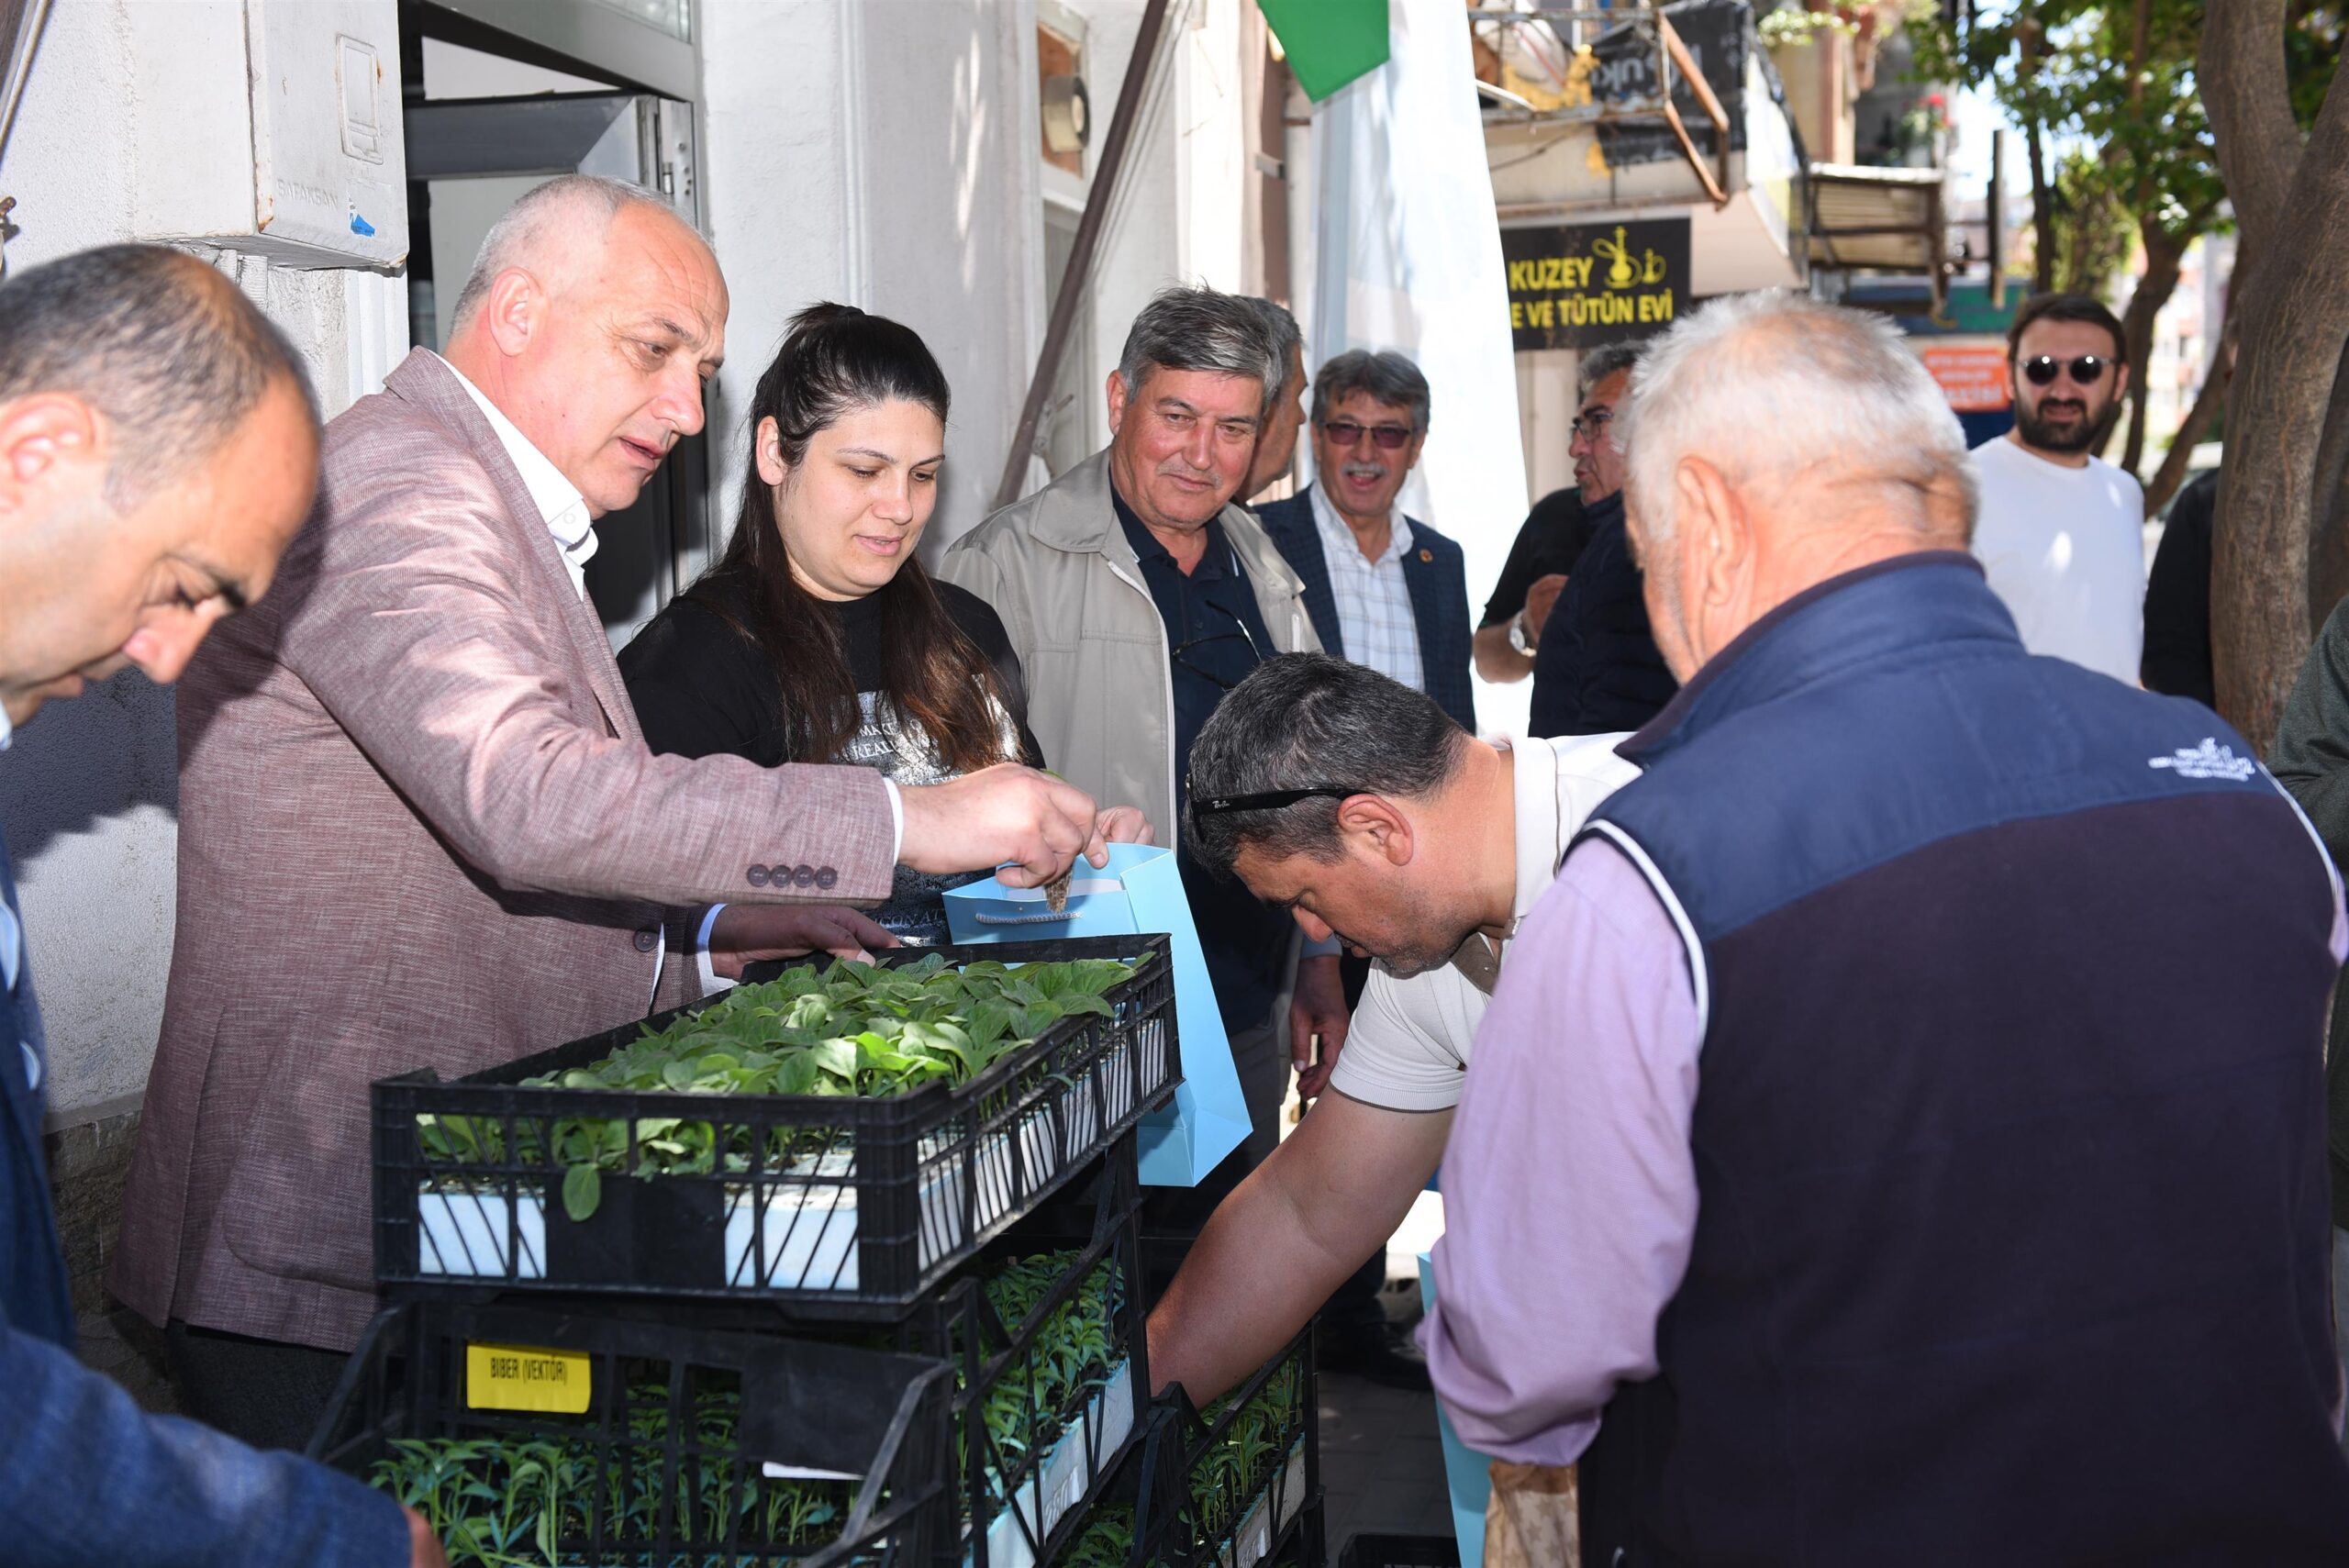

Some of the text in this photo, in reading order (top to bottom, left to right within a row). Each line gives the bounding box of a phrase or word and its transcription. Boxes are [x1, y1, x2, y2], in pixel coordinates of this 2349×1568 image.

[1509, 256, 1594, 291] KUZEY
[1526, 299, 1554, 328] VE
[1557, 290, 1634, 326] TÜTÜN
[1638, 287, 1673, 322] EVİ
